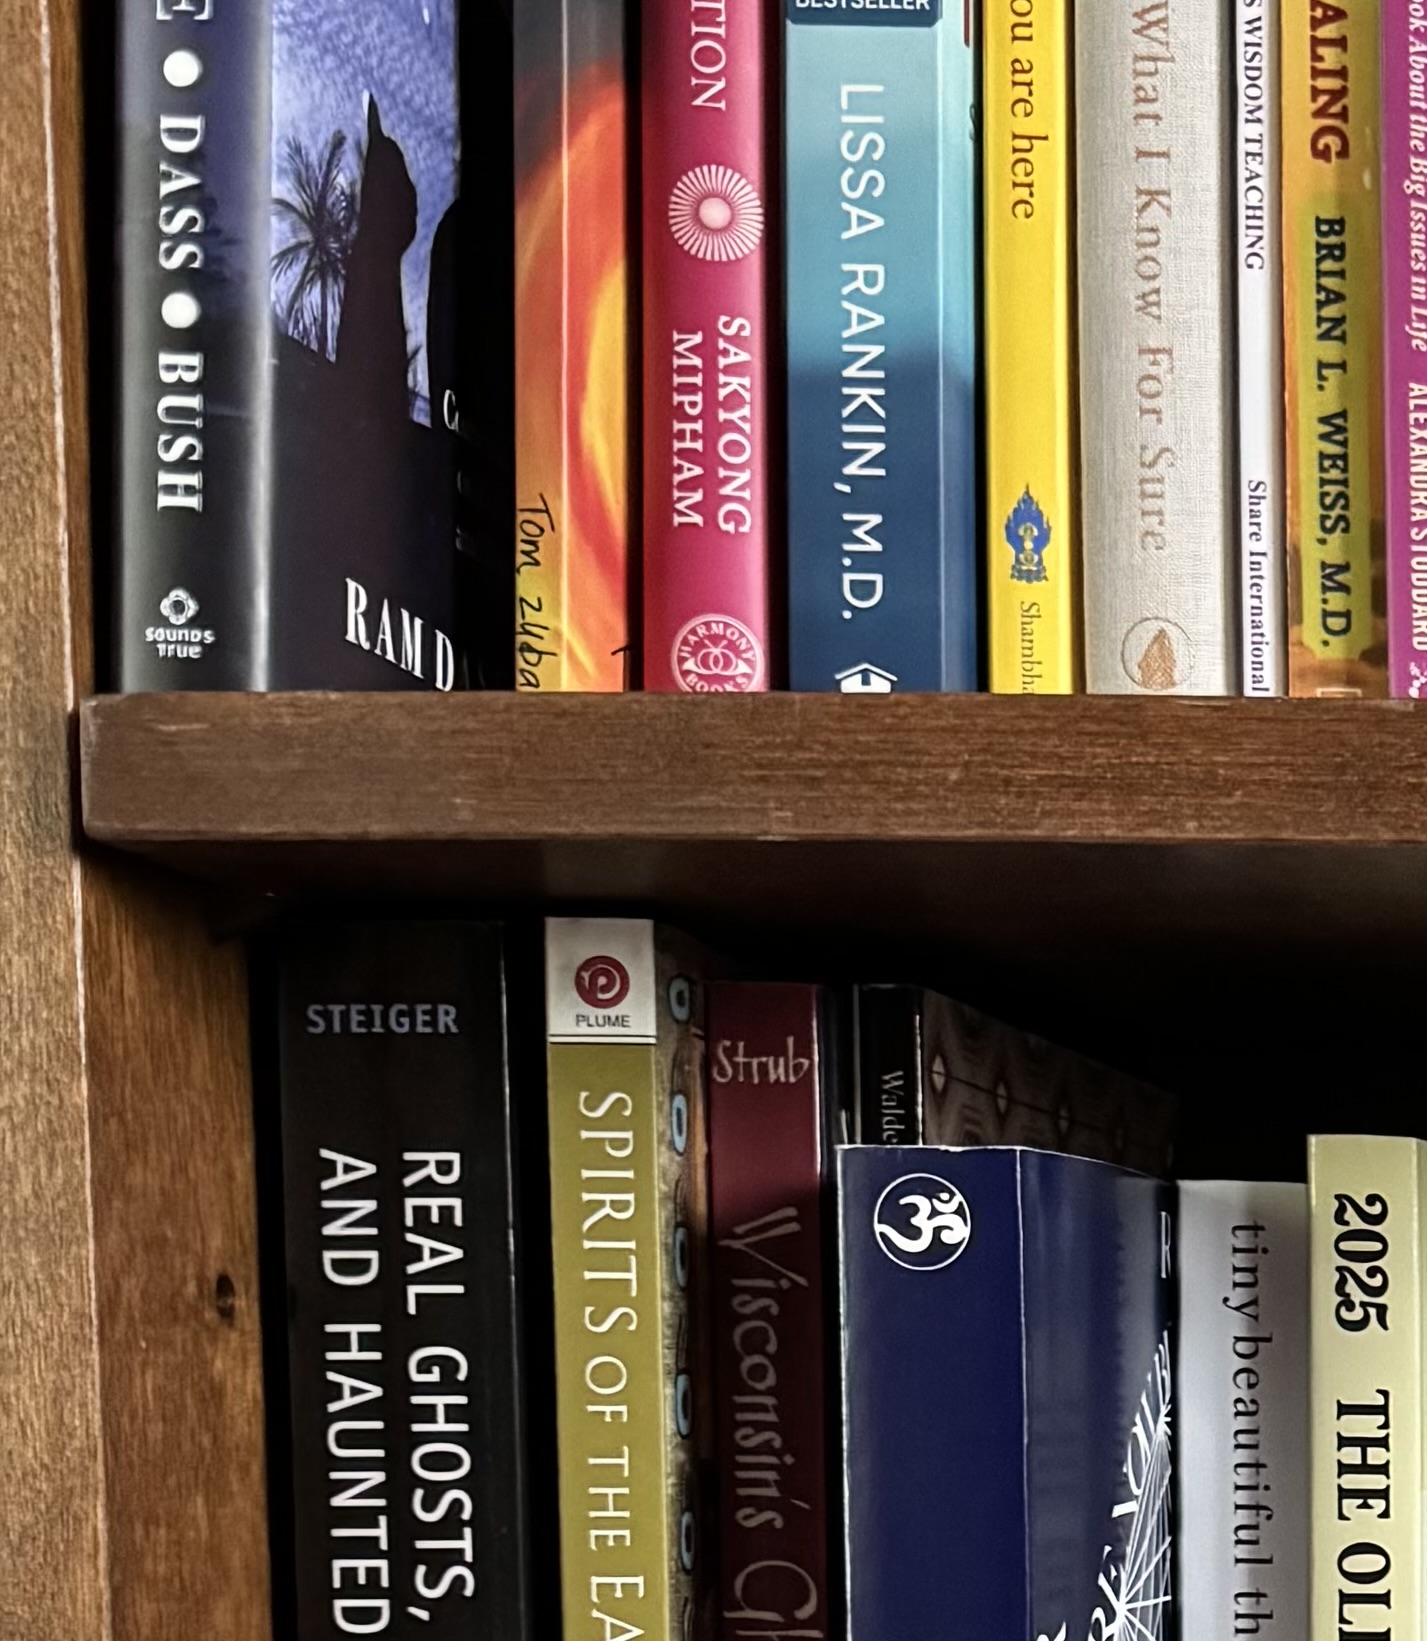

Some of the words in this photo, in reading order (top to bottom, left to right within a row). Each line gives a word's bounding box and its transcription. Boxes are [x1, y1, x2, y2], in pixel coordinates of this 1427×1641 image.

[672, 331, 704, 527] MIPHAM
[717, 315, 753, 535] SAKYONG
[1247, 479, 1268, 542] Share
[1248, 550, 1270, 694] International
[306, 1003, 459, 1034] STEIGER
[318, 1148, 380, 1286] AND
[402, 1149, 465, 1315] REAL
[579, 1091, 638, 1334] SPIRITS
[1222, 1220, 1266, 1322] tiny
[1333, 1193, 1390, 1332] 2025
[585, 1355, 628, 1424] OF
[1231, 1334, 1274, 1566] beautiful
[1336, 1388, 1391, 1521] THE
[324, 1323, 390, 1633] HAUNTED
[406, 1345, 475, 1622] GHOSTS,
[587, 1446, 631, 1551] THE
